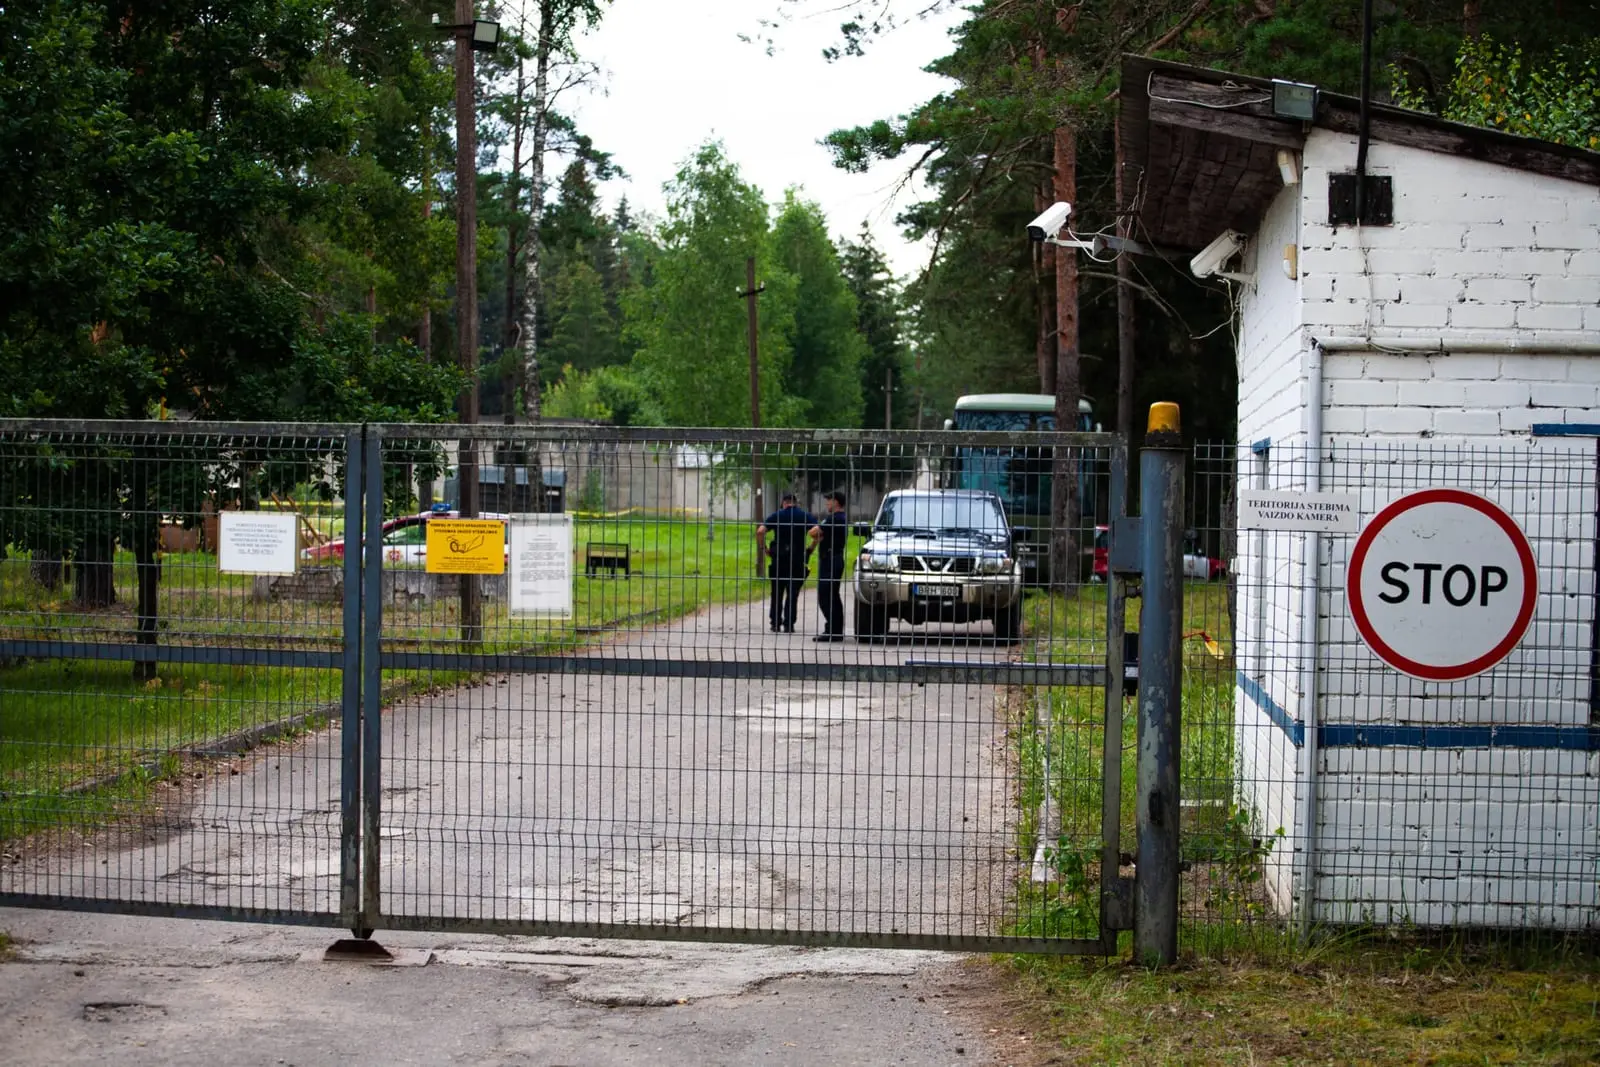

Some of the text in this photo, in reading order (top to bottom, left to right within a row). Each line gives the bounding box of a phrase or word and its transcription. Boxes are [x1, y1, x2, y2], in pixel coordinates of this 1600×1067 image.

[1247, 499, 1351, 512] TERITORIJA STEBIMA
[1258, 510, 1340, 522] VAIZDO KAMERA
[1378, 561, 1509, 607] STOP
